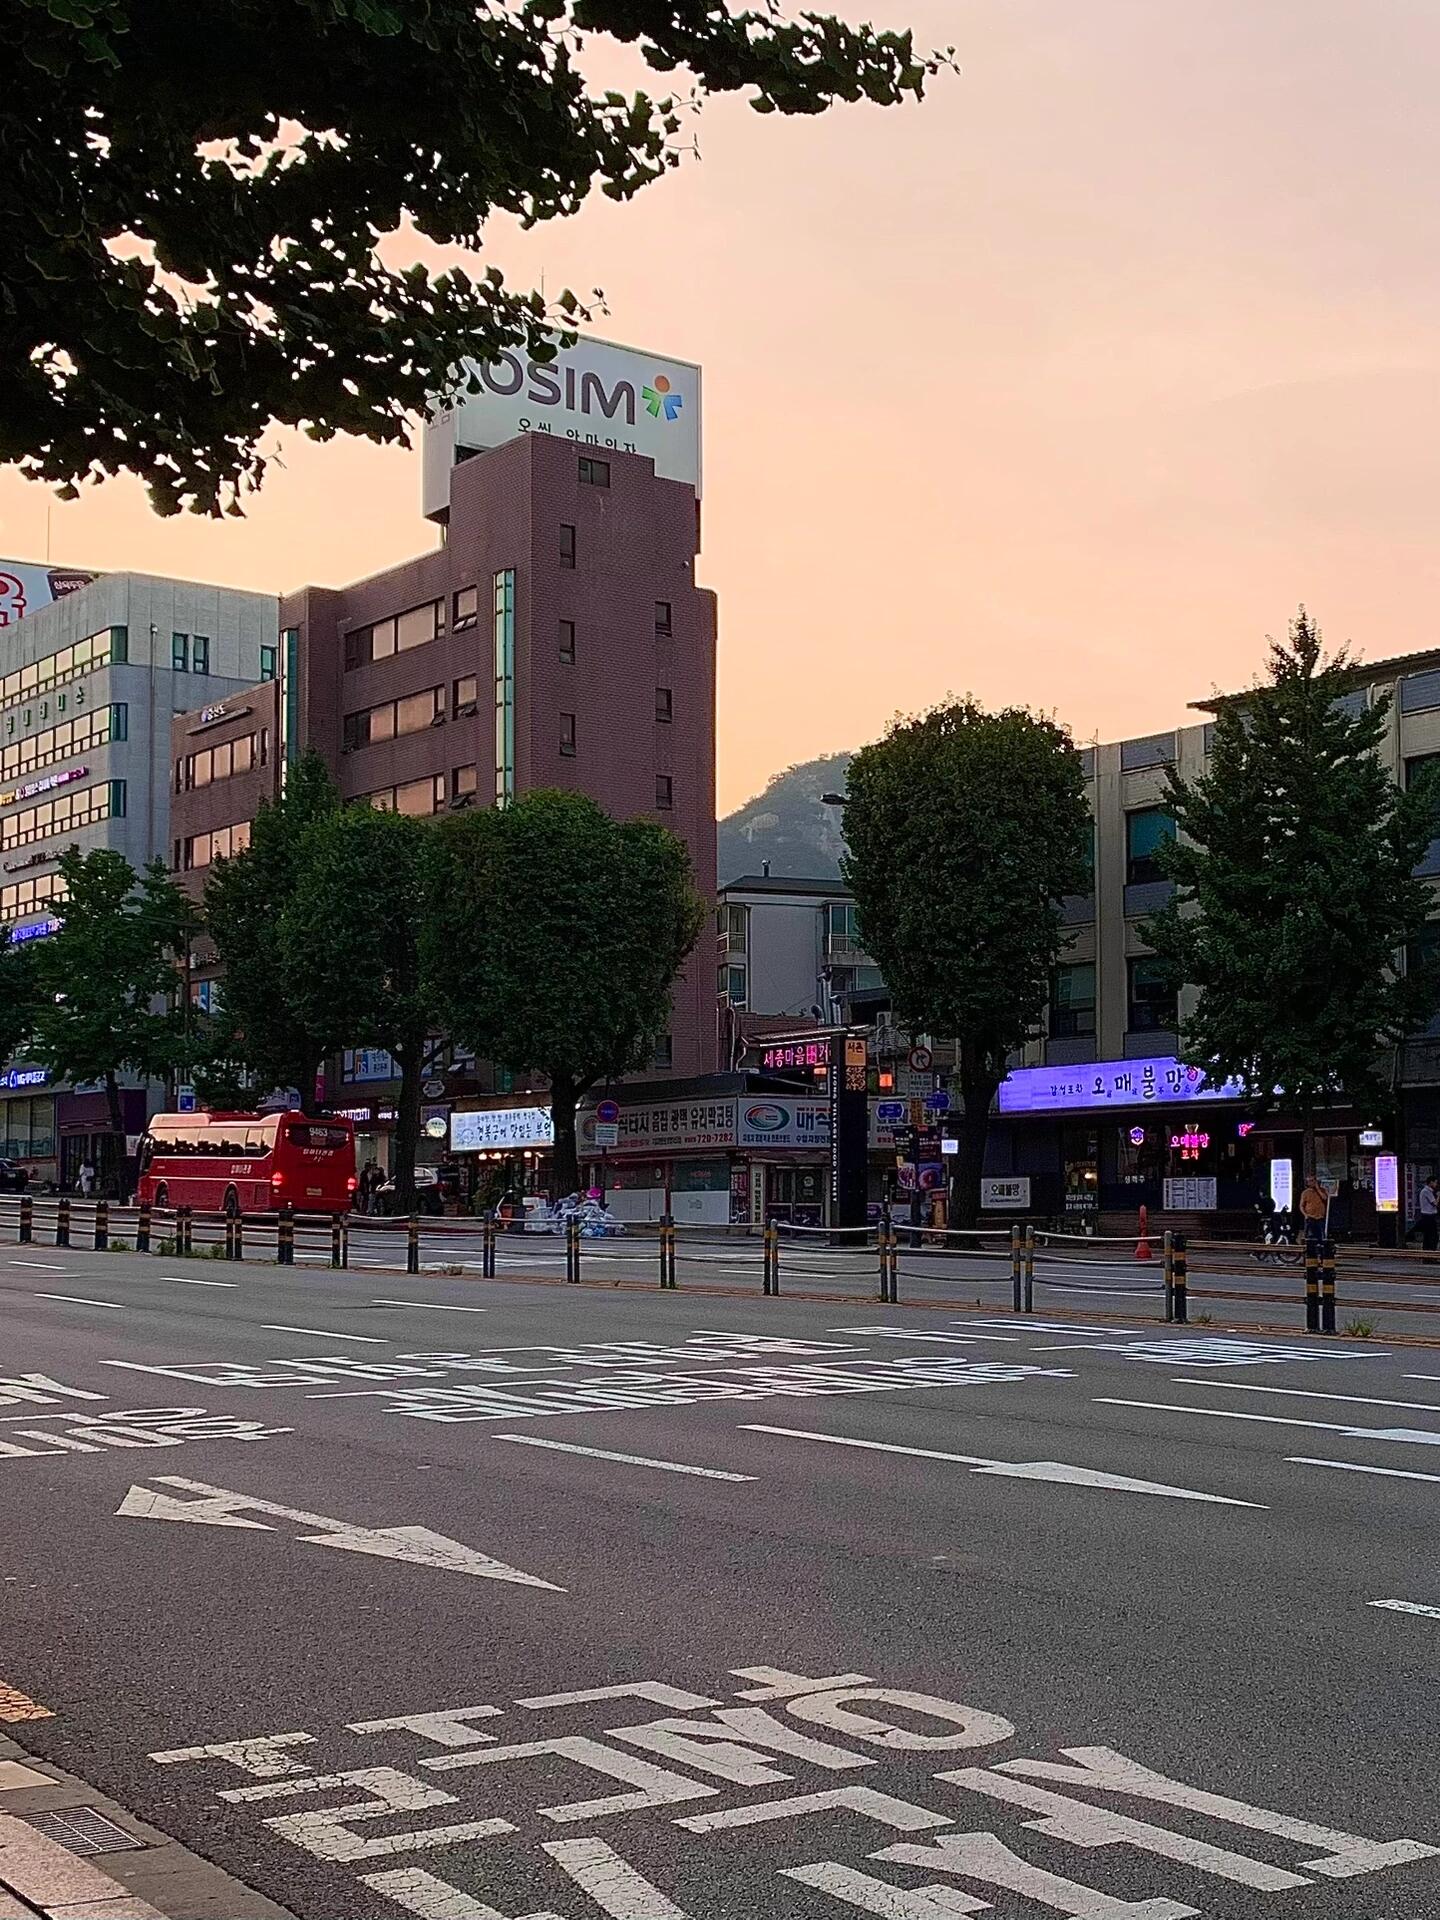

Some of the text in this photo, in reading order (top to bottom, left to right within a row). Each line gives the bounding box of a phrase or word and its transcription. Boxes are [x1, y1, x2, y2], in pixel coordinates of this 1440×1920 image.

[480, 350, 636, 426] OSIM
[1091, 1066, 1185, 1099] 오매불망
[150, 1665, 1016, 1863] 우선도로
